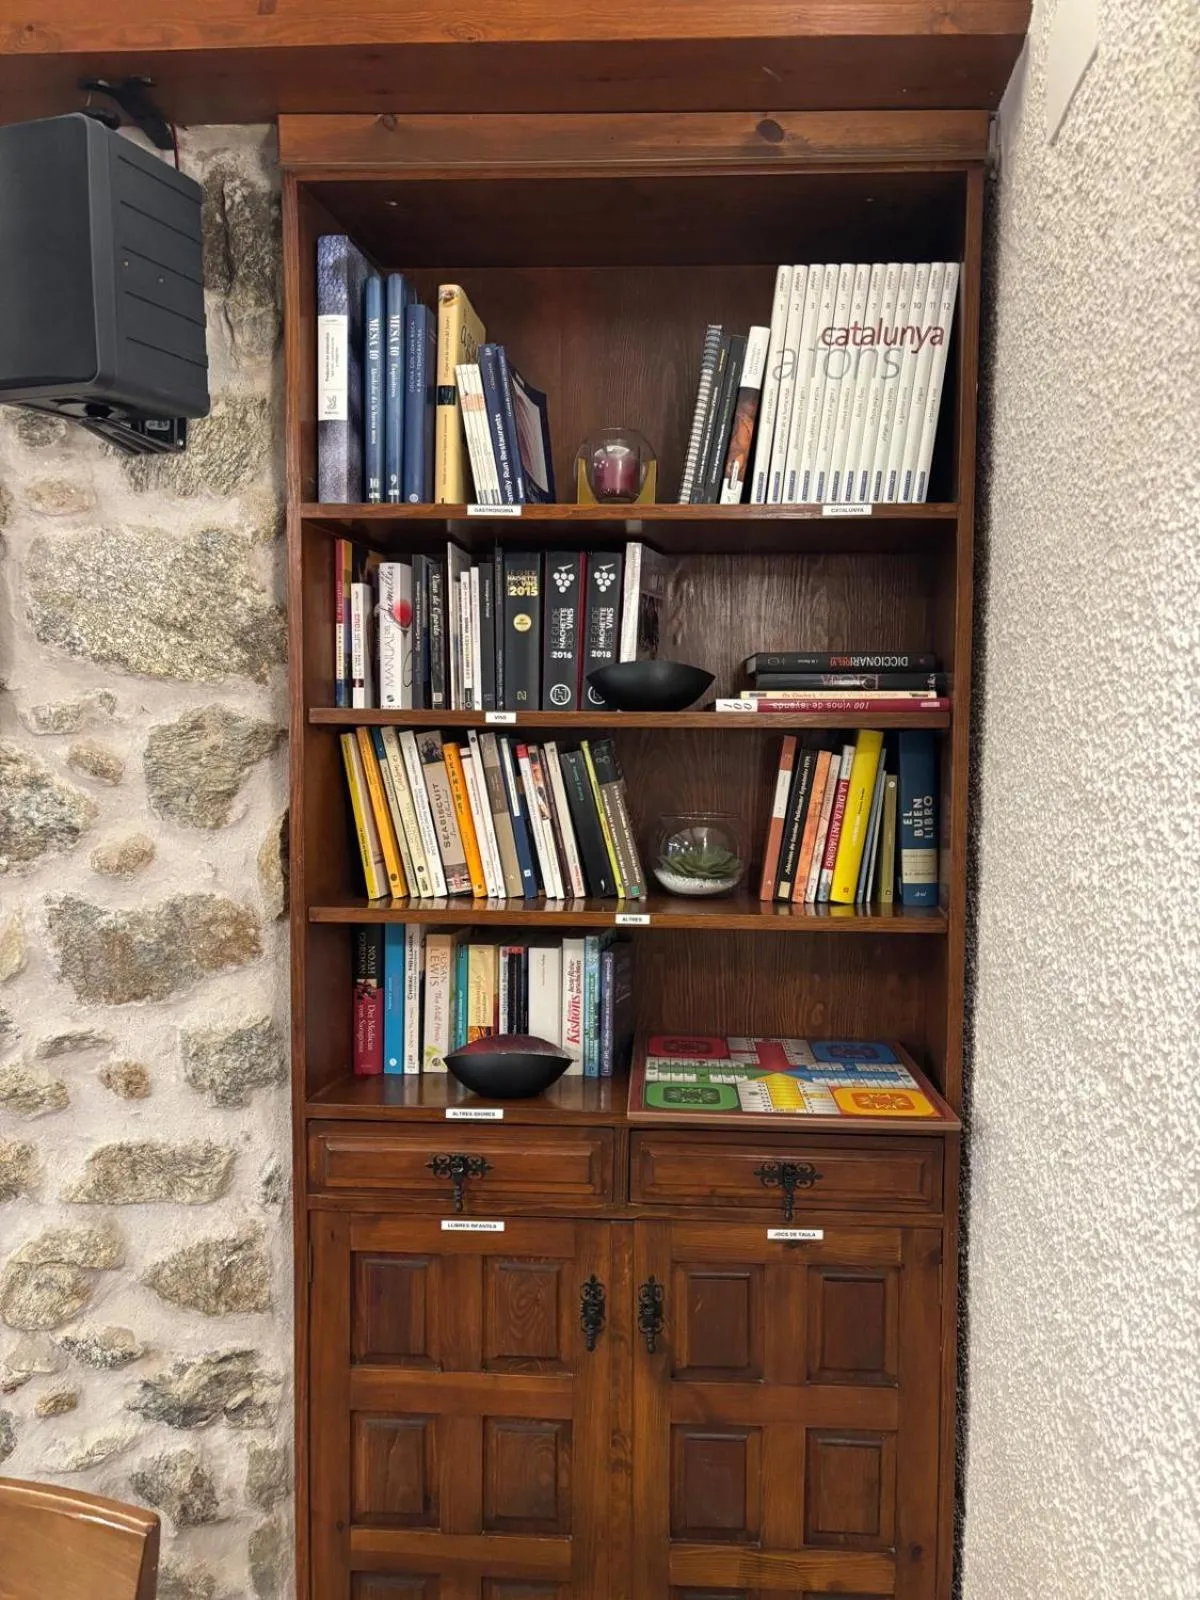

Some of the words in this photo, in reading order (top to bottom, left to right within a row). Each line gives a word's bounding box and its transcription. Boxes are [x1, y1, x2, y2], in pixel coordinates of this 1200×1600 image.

[822, 317, 945, 354] catalunya
[772, 348, 797, 381] a
[808, 334, 902, 380] fons
[495, 413, 507, 461] Restaurants
[502, 462, 511, 478] Run
[508, 586, 539, 597] 2015
[559, 607, 567, 649] HACHETTE
[566, 607, 574, 629] VINS
[599, 607, 607, 648] HACHETTE
[606, 607, 614, 629] VINS
[383, 636, 395, 688] MANUAL
[551, 650, 573, 659] 2016
[590, 649, 612, 658] 2018
[811, 702, 823, 710] de
[826, 702, 852, 710] vinos
[854, 702, 870, 710] 100
[838, 781, 849, 793] LA
[433, 783, 451, 848] SEABISCUIT
[834, 793, 847, 820] DIETA
[902, 810, 913, 825] EL
[912, 798, 924, 837] BUEN
[923, 795, 934, 839] LIBRO
[826, 819, 842, 867] ANTIAGING
[367, 945, 377, 974] NOAH
[429, 948, 440, 987] LEWIS
[440, 951, 448, 983] SUSAN
[367, 1004, 376, 1018] Der
[566, 994, 581, 1044] Kishons
[367, 1020, 376, 1051] Medicus
